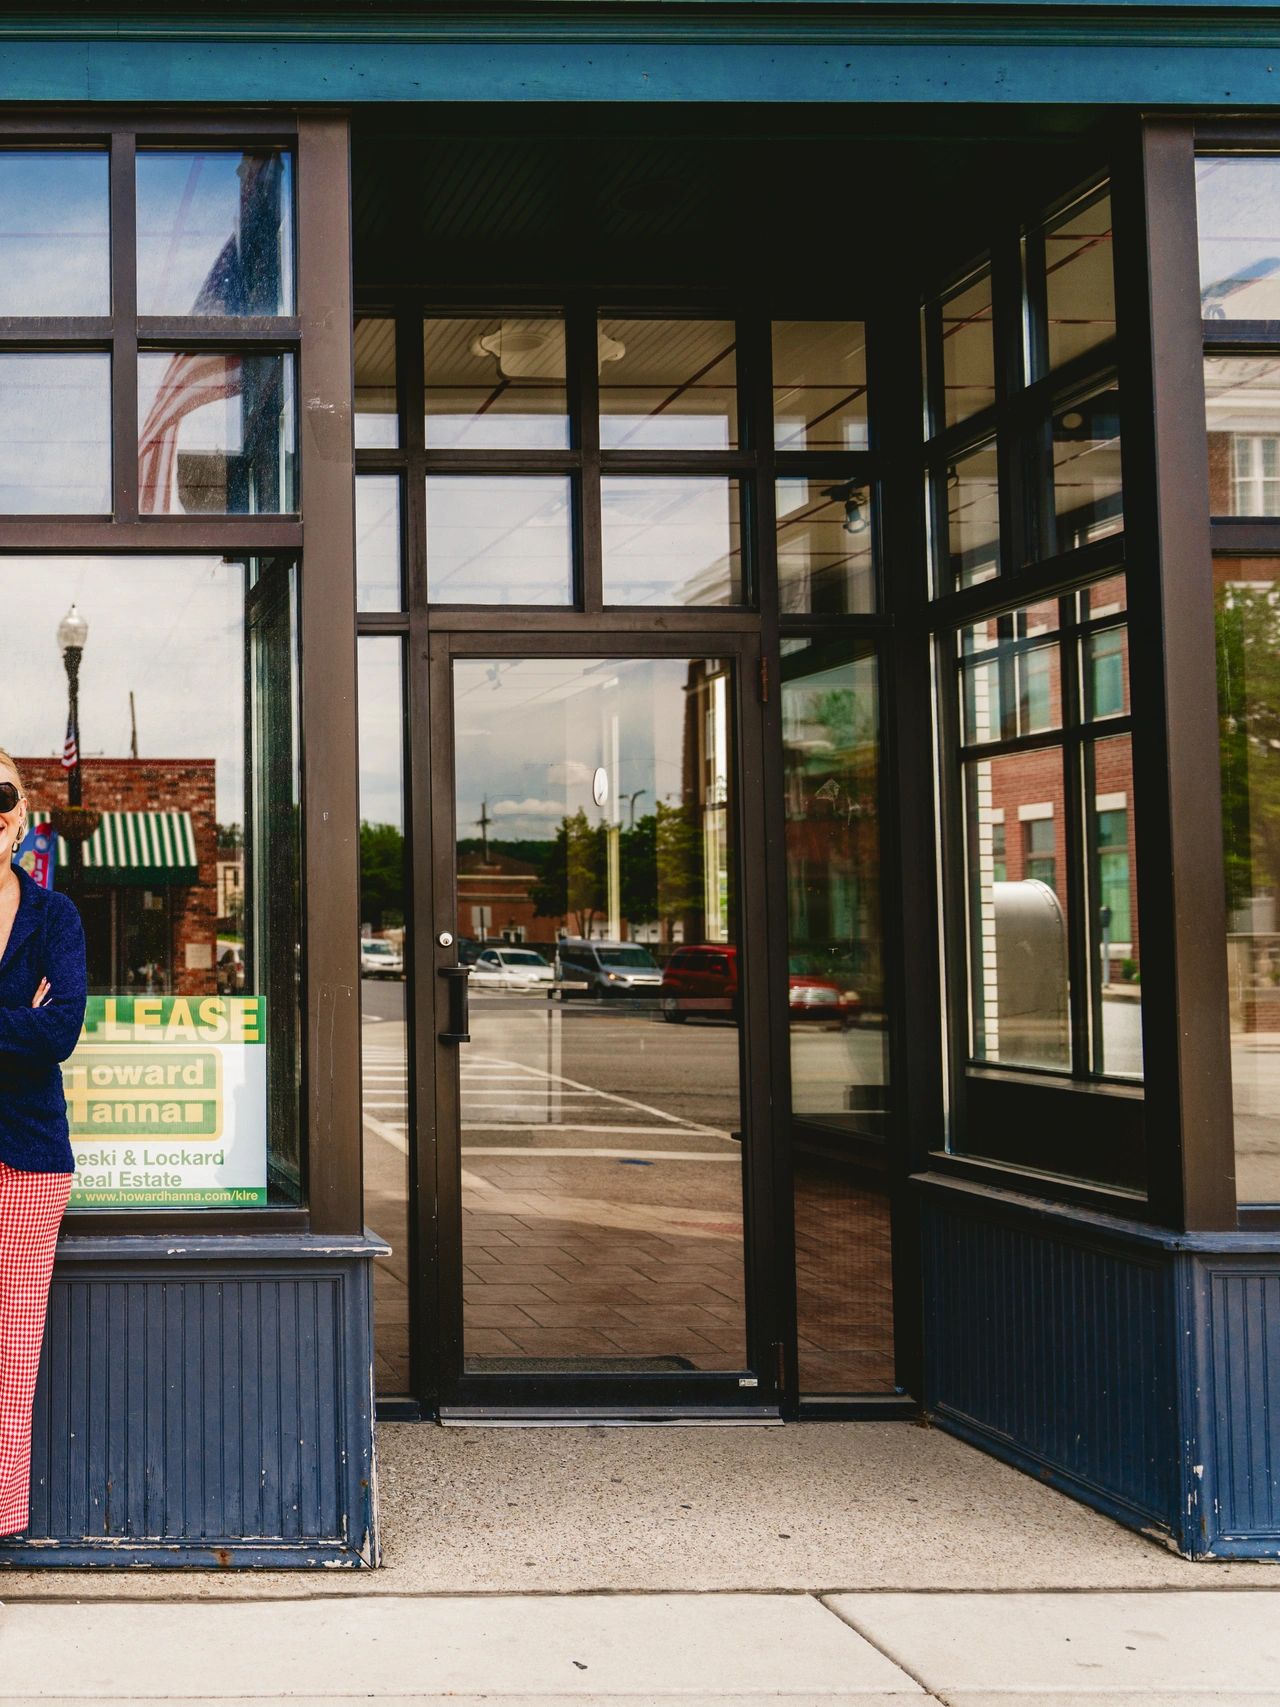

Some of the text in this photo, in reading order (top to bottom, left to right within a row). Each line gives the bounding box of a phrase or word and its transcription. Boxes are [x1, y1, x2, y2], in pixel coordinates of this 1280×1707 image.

[105, 998, 259, 1041] LEASE
[76, 1149, 224, 1166] eski & Lockard
[71, 1171, 182, 1187] Real Estate
[85, 1190, 258, 1202] www.howardhanna.com/klre
